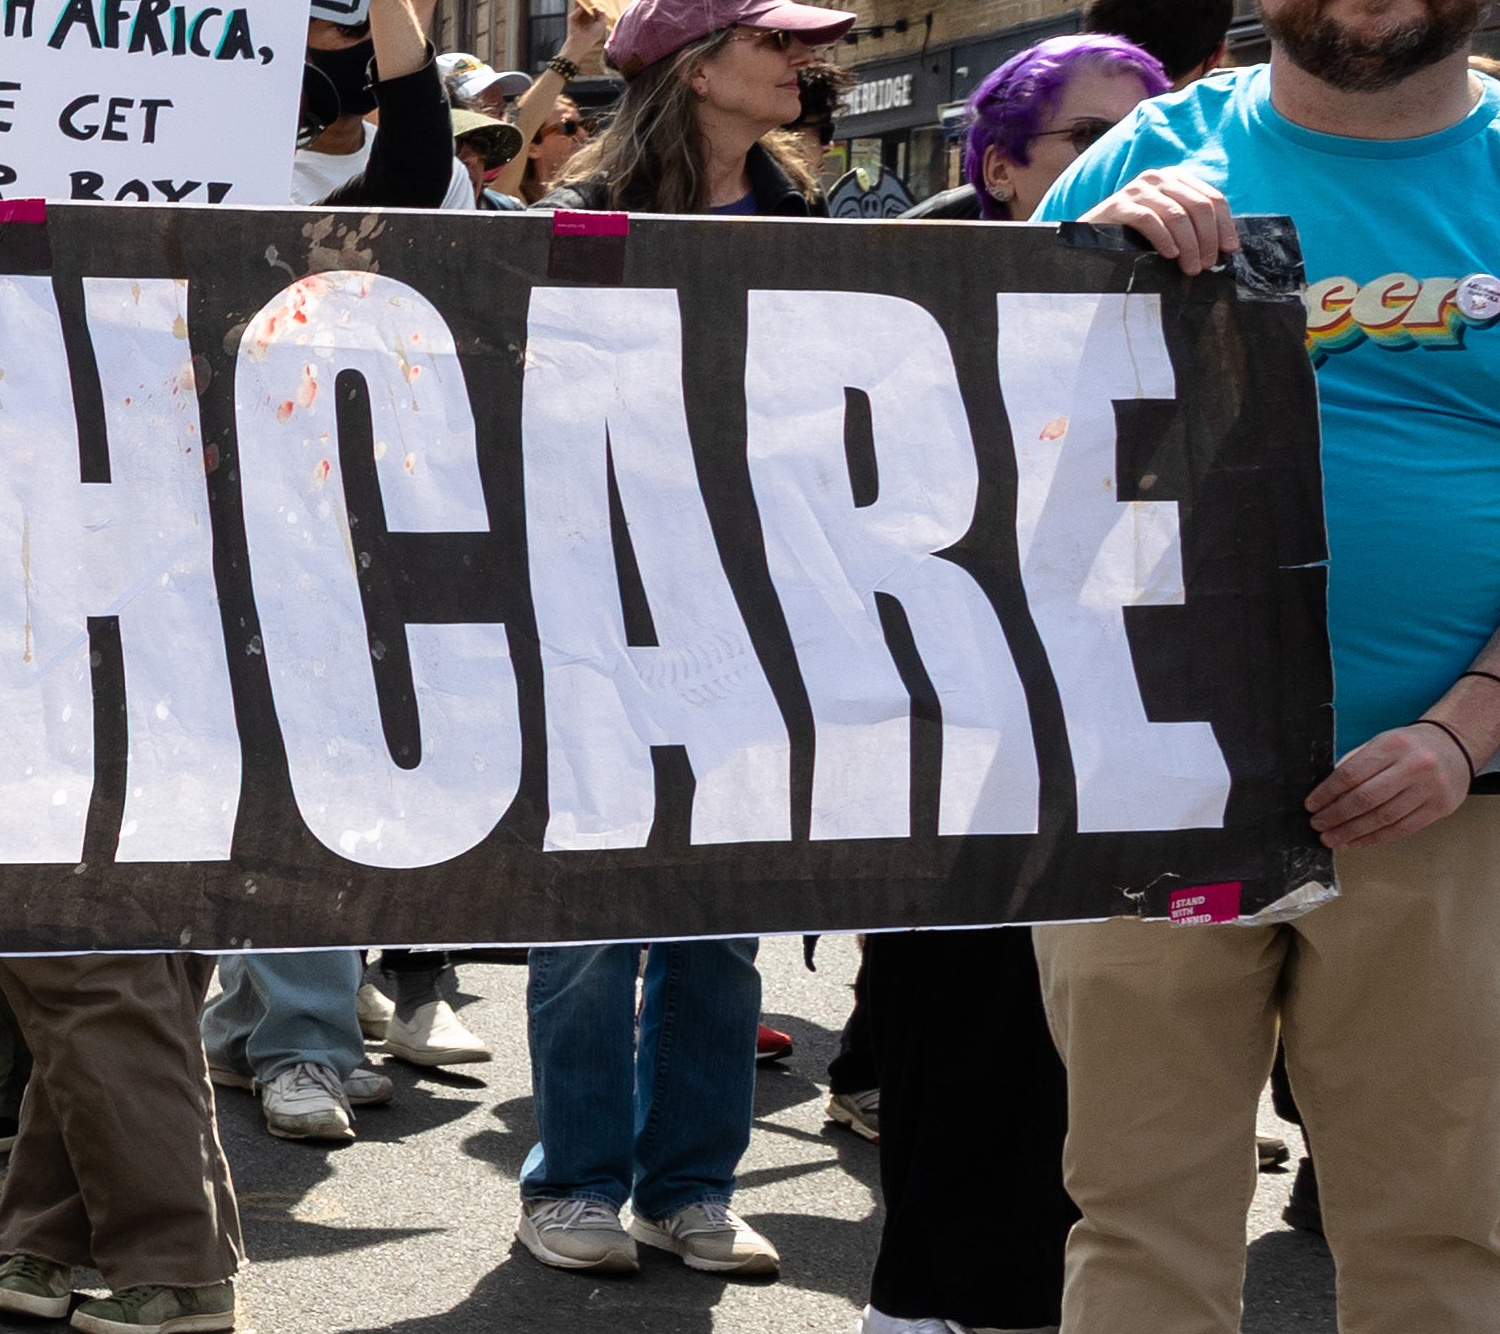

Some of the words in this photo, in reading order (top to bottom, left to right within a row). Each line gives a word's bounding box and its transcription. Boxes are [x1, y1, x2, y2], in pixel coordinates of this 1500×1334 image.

[58, 94, 175, 144] GET
[1171, 901, 1176, 910] I
[1176, 895, 1206, 908] STAND
[1171, 907, 1195, 918] WITH
